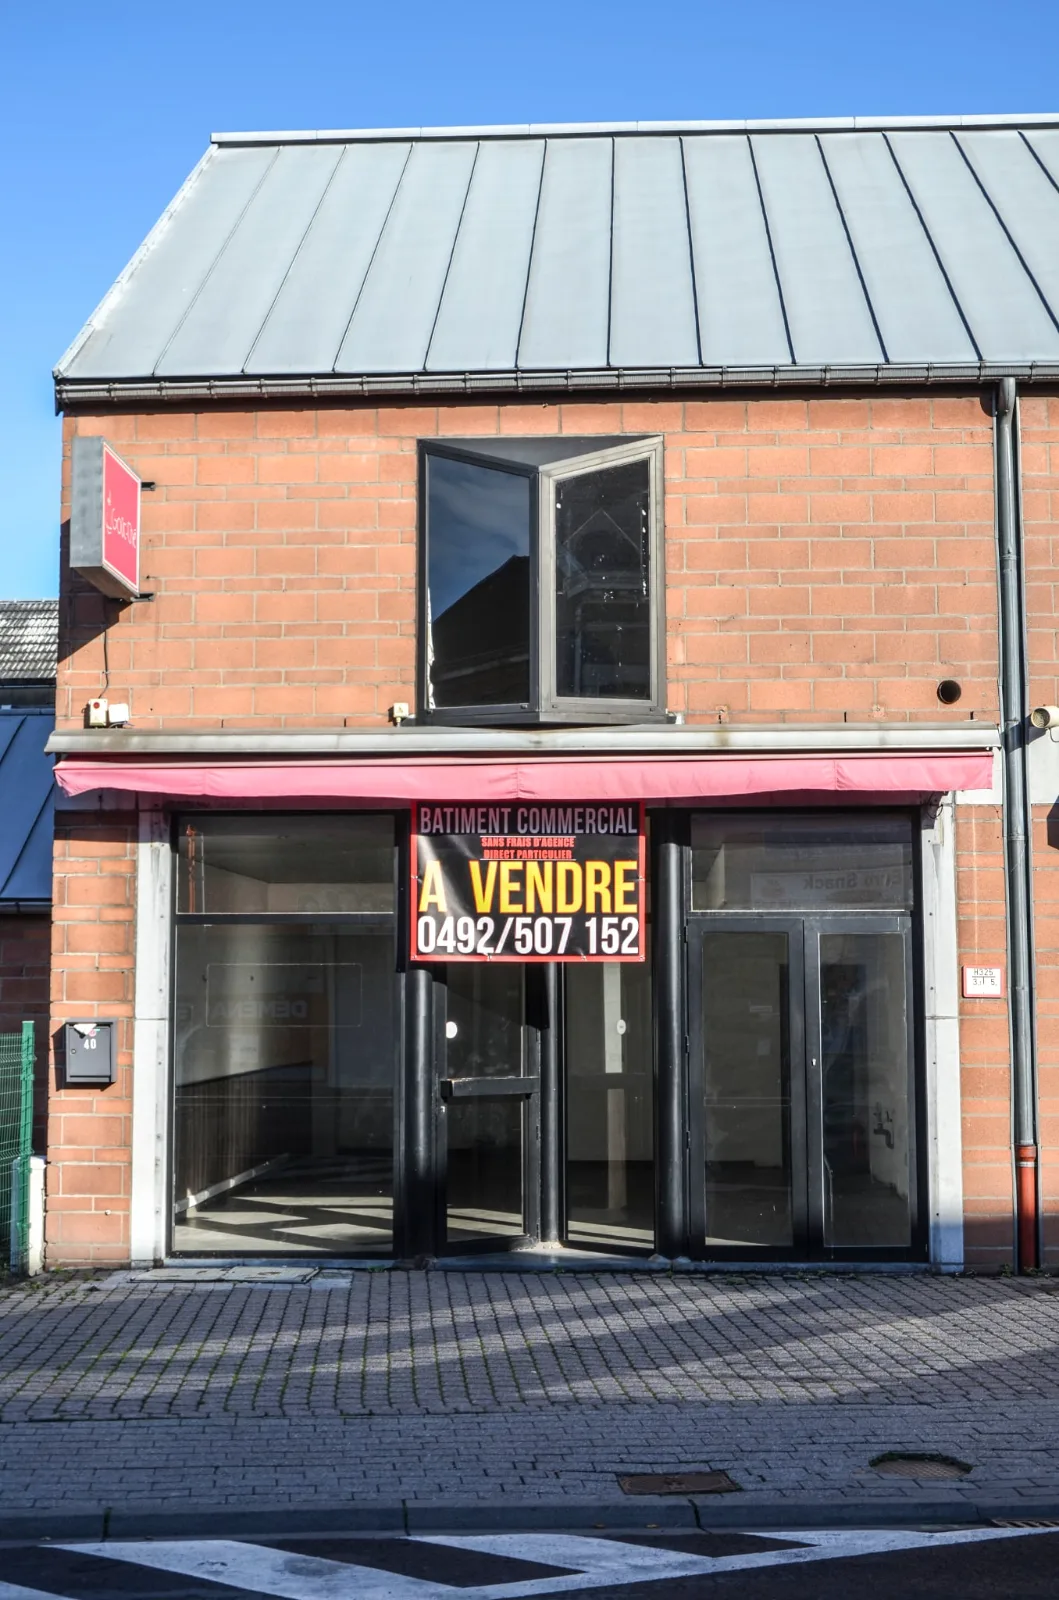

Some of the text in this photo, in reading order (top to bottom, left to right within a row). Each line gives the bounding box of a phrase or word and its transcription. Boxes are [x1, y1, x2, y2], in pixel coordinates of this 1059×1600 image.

[420, 807, 637, 834] BATIMENT COMMERCIAL
[481, 837, 574, 847] SANS FRAIS D'AGENCE
[483, 849, 572, 859] DIRECT PARTICULIER
[418, 860, 638, 914] A VENDRE
[417, 916, 639, 954] 0492/507 152
[83, 1038, 97, 1050] 40
